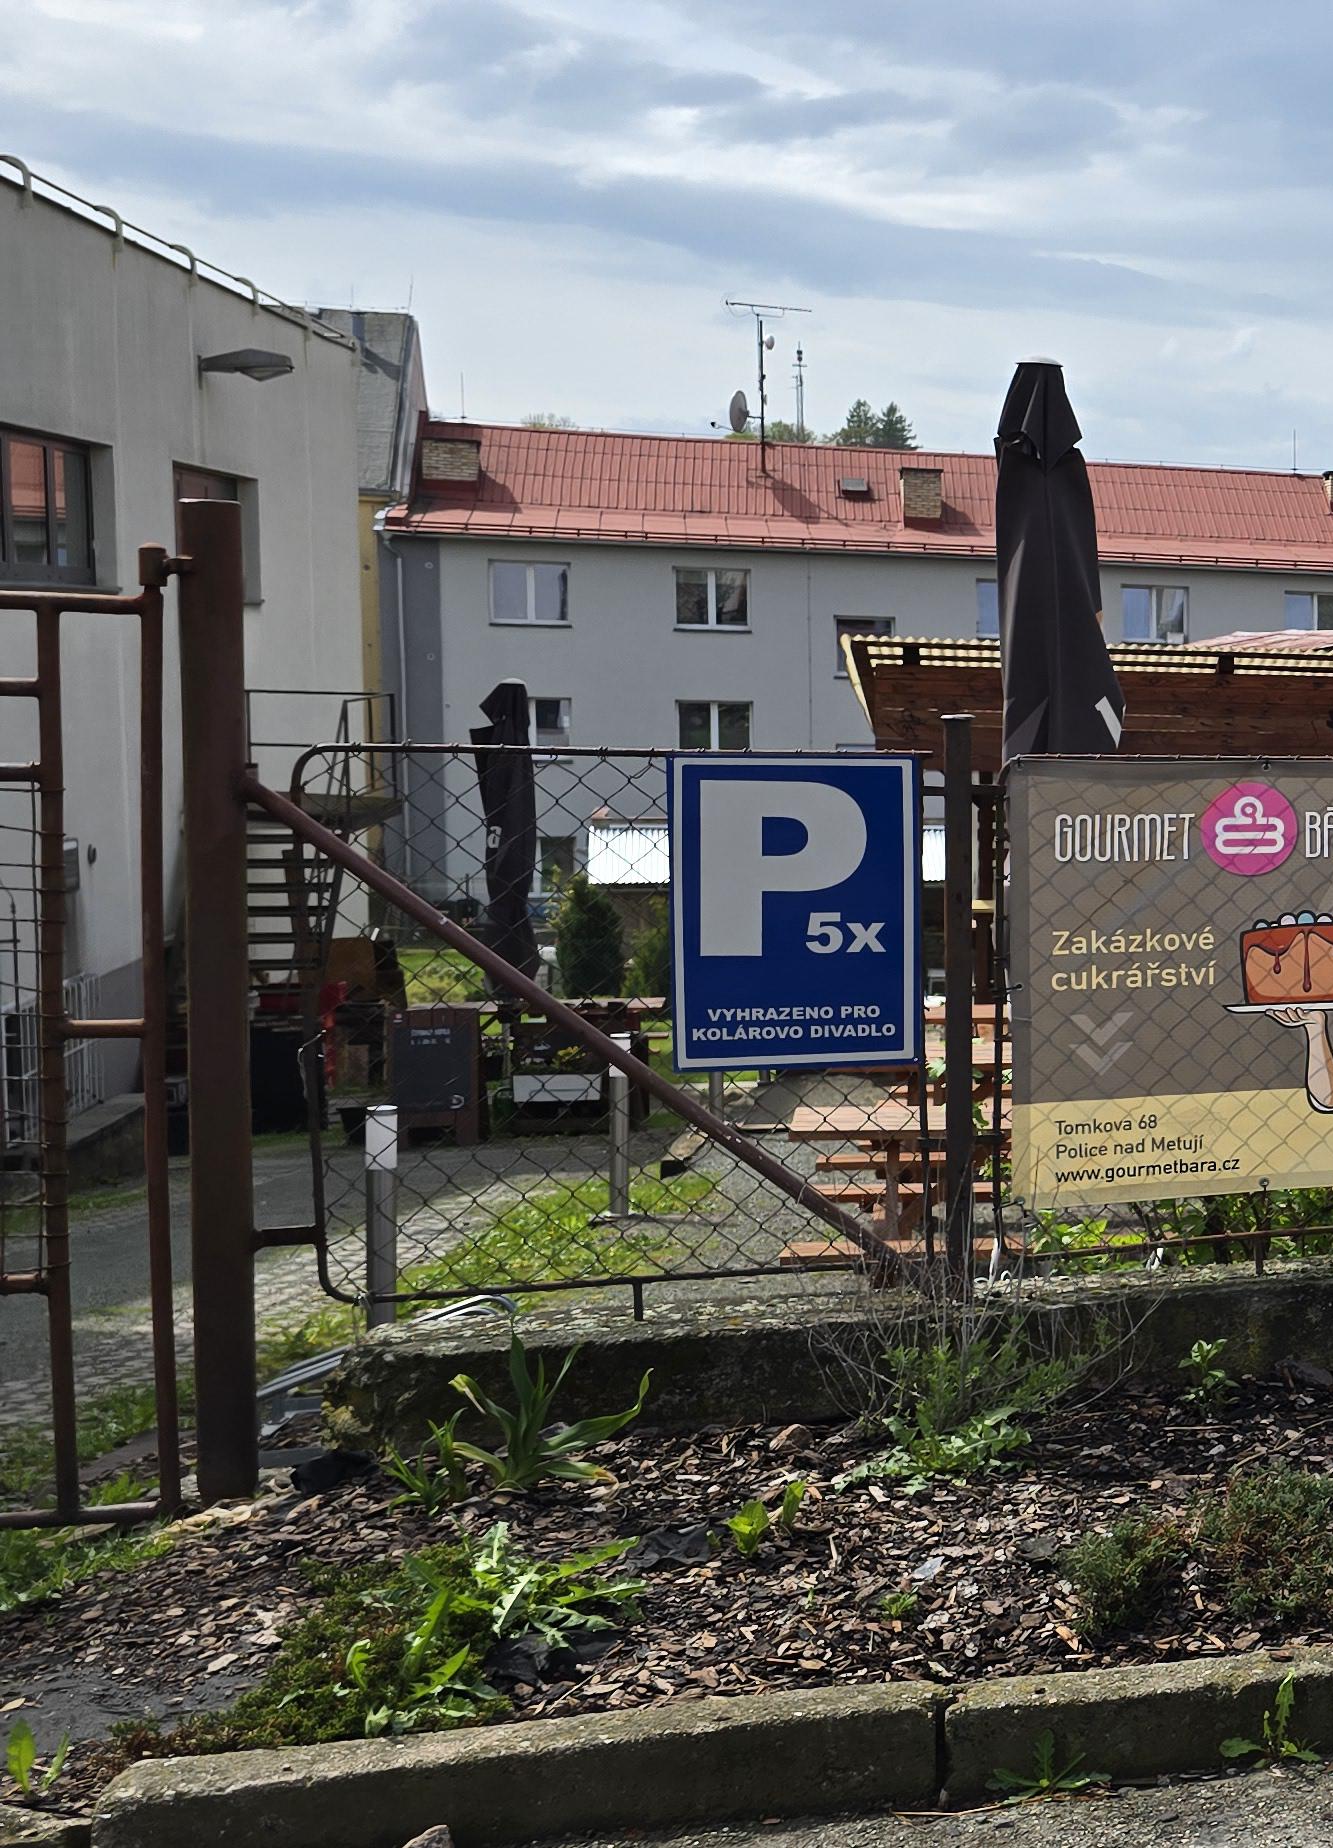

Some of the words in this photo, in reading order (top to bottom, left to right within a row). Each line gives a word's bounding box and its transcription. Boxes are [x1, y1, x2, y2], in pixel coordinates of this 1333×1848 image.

[1054, 812, 1195, 862] GOURMET
[700, 780, 867, 956] P
[805, 912, 887, 954] 5x
[1052, 926, 1216, 956] Zakázkové
[1051, 960, 1216, 992] cukrářství
[707, 1005, 834, 1022] VYHRAZENO
[840, 1004, 881, 1018] PRO
[692, 1023, 803, 1041] KOLÁROVO
[810, 1022, 896, 1038] DIVADLO
[1055, 1119, 1132, 1136] Tomkova
[1138, 1114, 1158, 1130] 68
[1055, 1142, 1108, 1160] Police
[1113, 1138, 1146, 1155] nad
[1151, 1134, 1204, 1154] Metují
[1055, 1158, 1241, 1183] www.gourmetbara.cz
